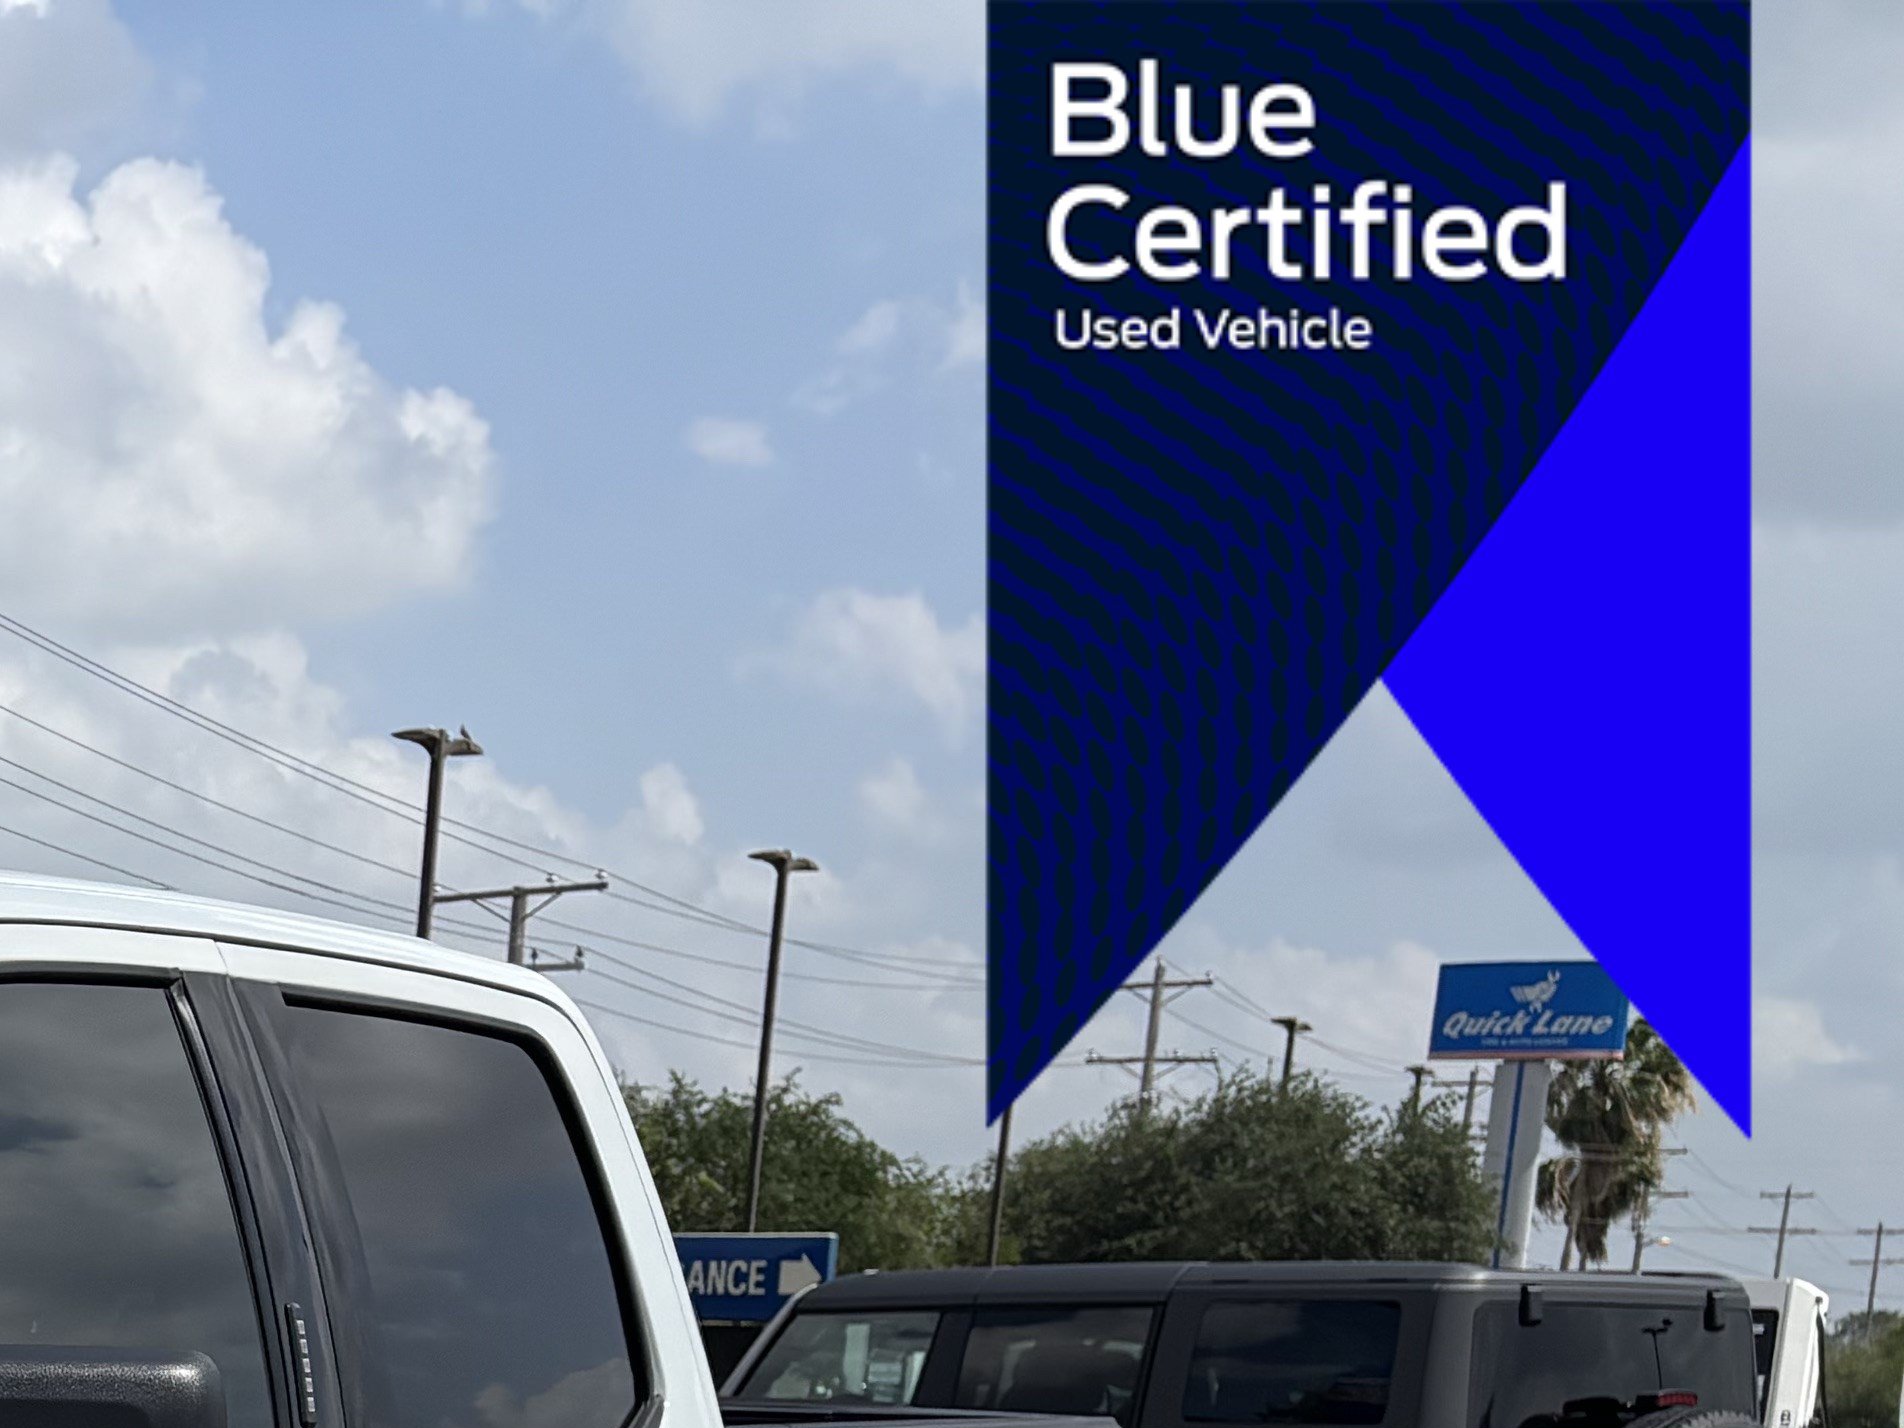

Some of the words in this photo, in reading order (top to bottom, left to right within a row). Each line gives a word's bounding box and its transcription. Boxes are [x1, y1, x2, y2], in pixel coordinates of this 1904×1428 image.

[1442, 1010, 1532, 1040] Quick
[1532, 1009, 1614, 1035] Lane
[687, 1259, 768, 1297] ANCE
